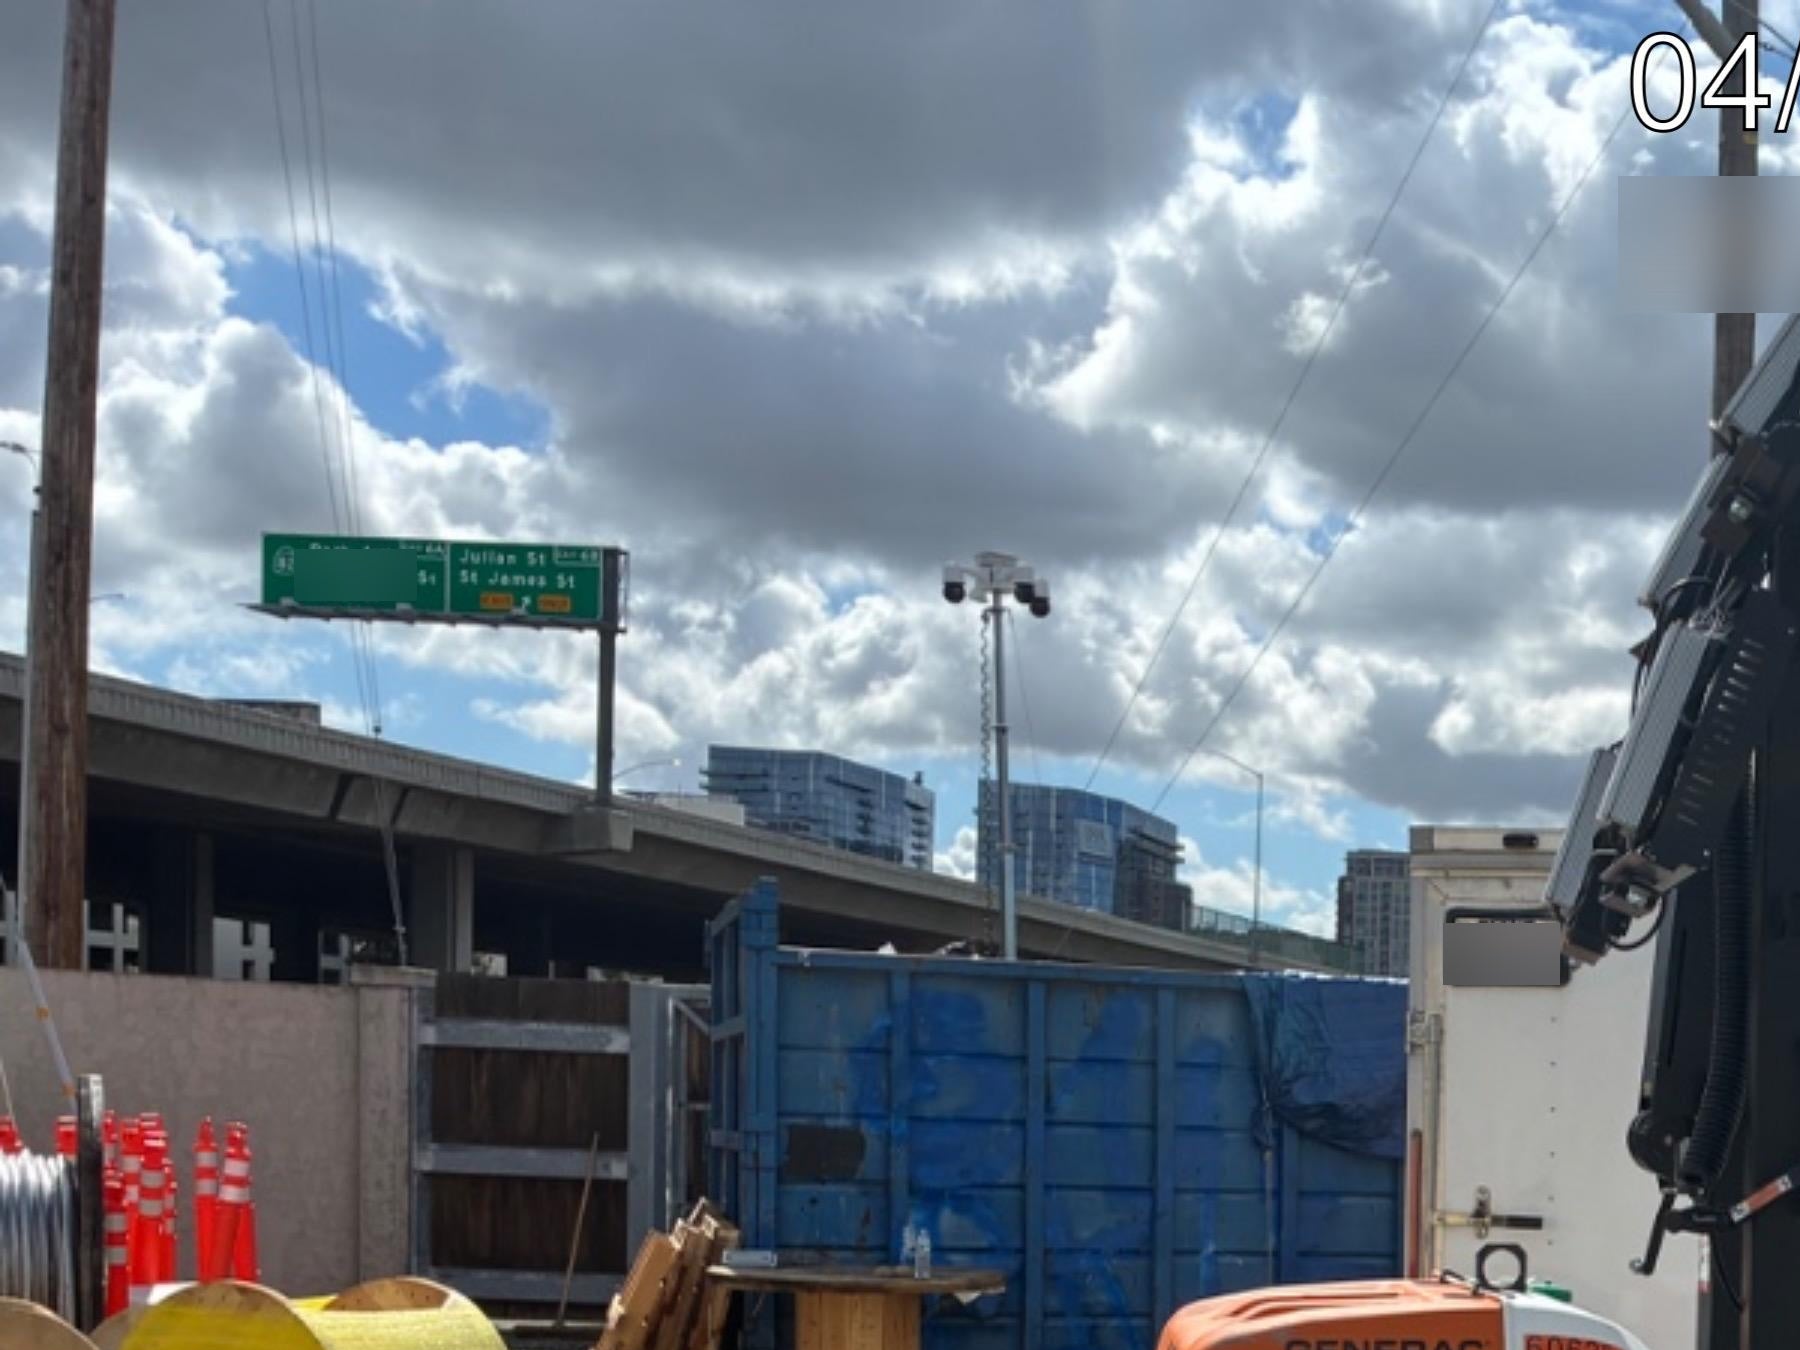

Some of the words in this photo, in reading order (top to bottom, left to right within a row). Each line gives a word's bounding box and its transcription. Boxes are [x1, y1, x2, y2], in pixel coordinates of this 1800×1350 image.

[459, 550, 517, 565] Julian
[527, 551, 546, 567] St
[459, 569, 478, 585] St
[488, 572, 547, 588] James
[557, 573, 576, 589] St
